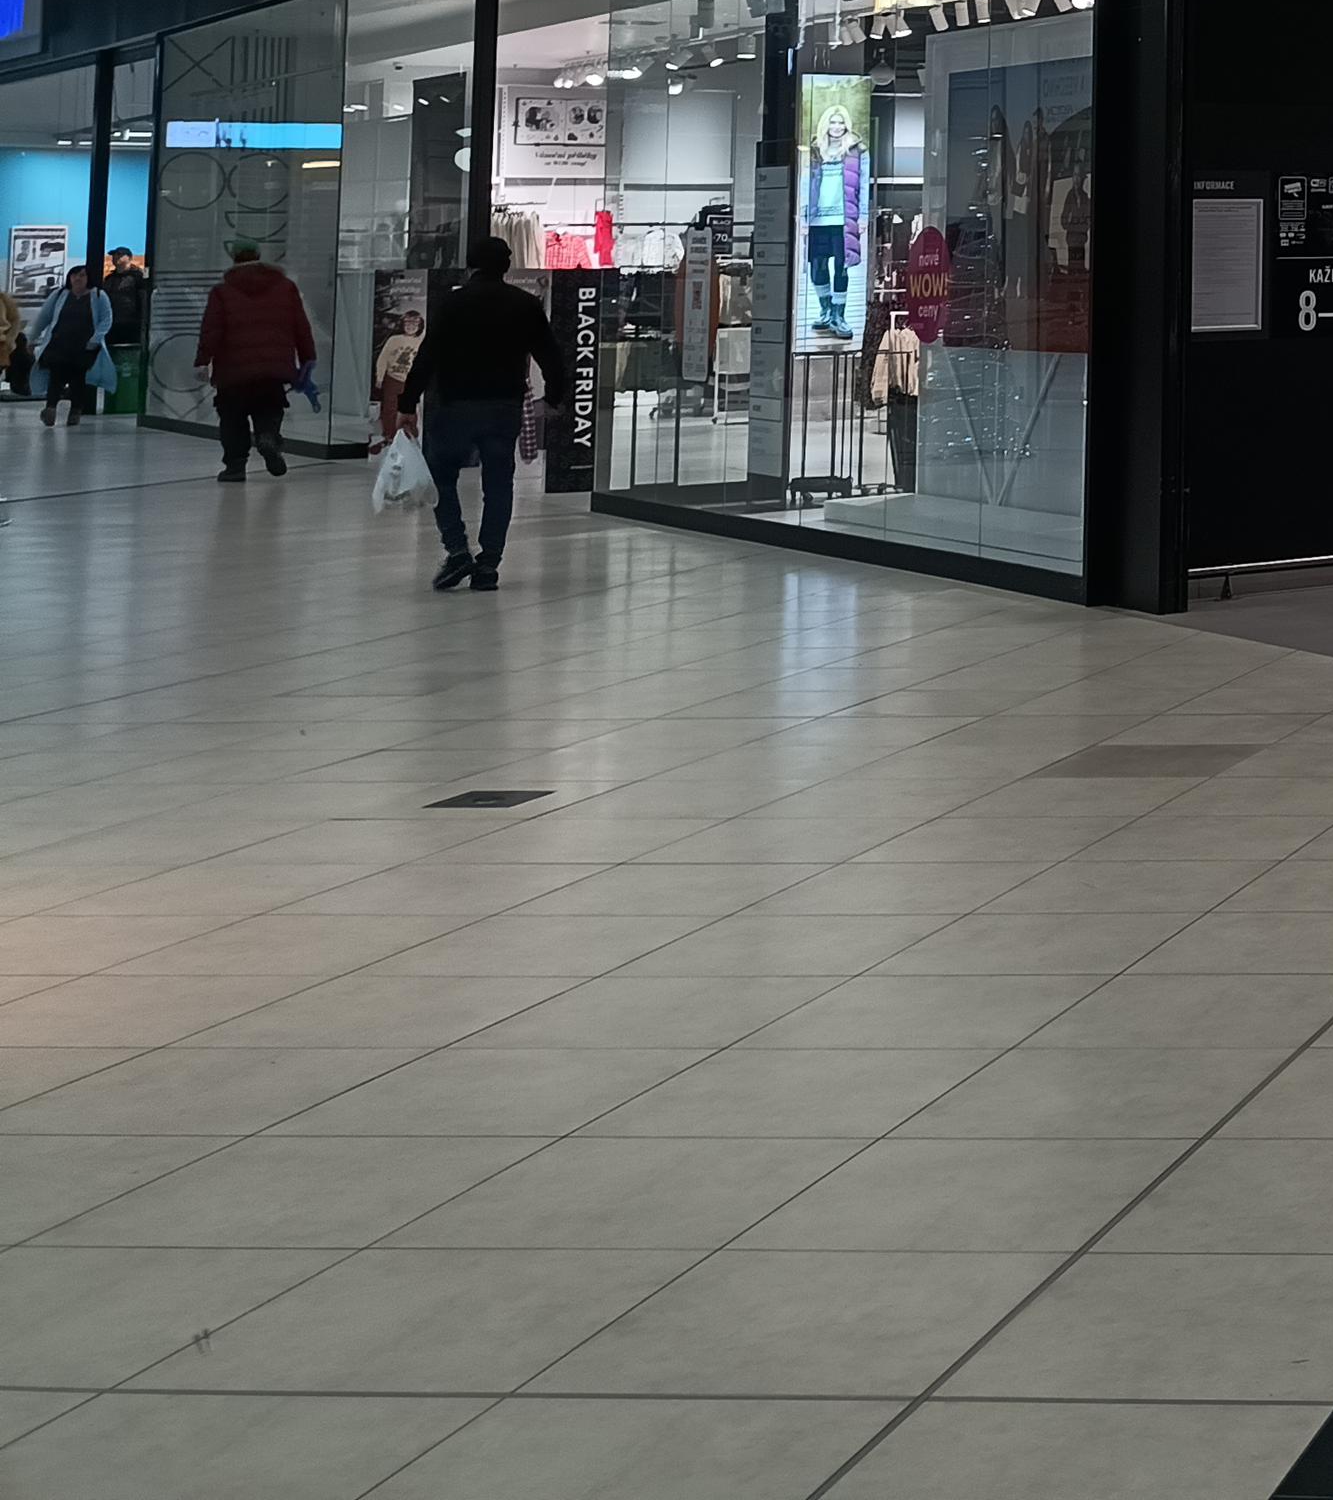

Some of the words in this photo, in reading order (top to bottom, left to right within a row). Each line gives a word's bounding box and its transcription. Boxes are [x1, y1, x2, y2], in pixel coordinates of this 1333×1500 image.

[918, 248, 939, 267] nové
[909, 272, 947, 298] WOW!
[576, 287, 597, 362] BLACK
[572, 367, 595, 449] FRIDAY
